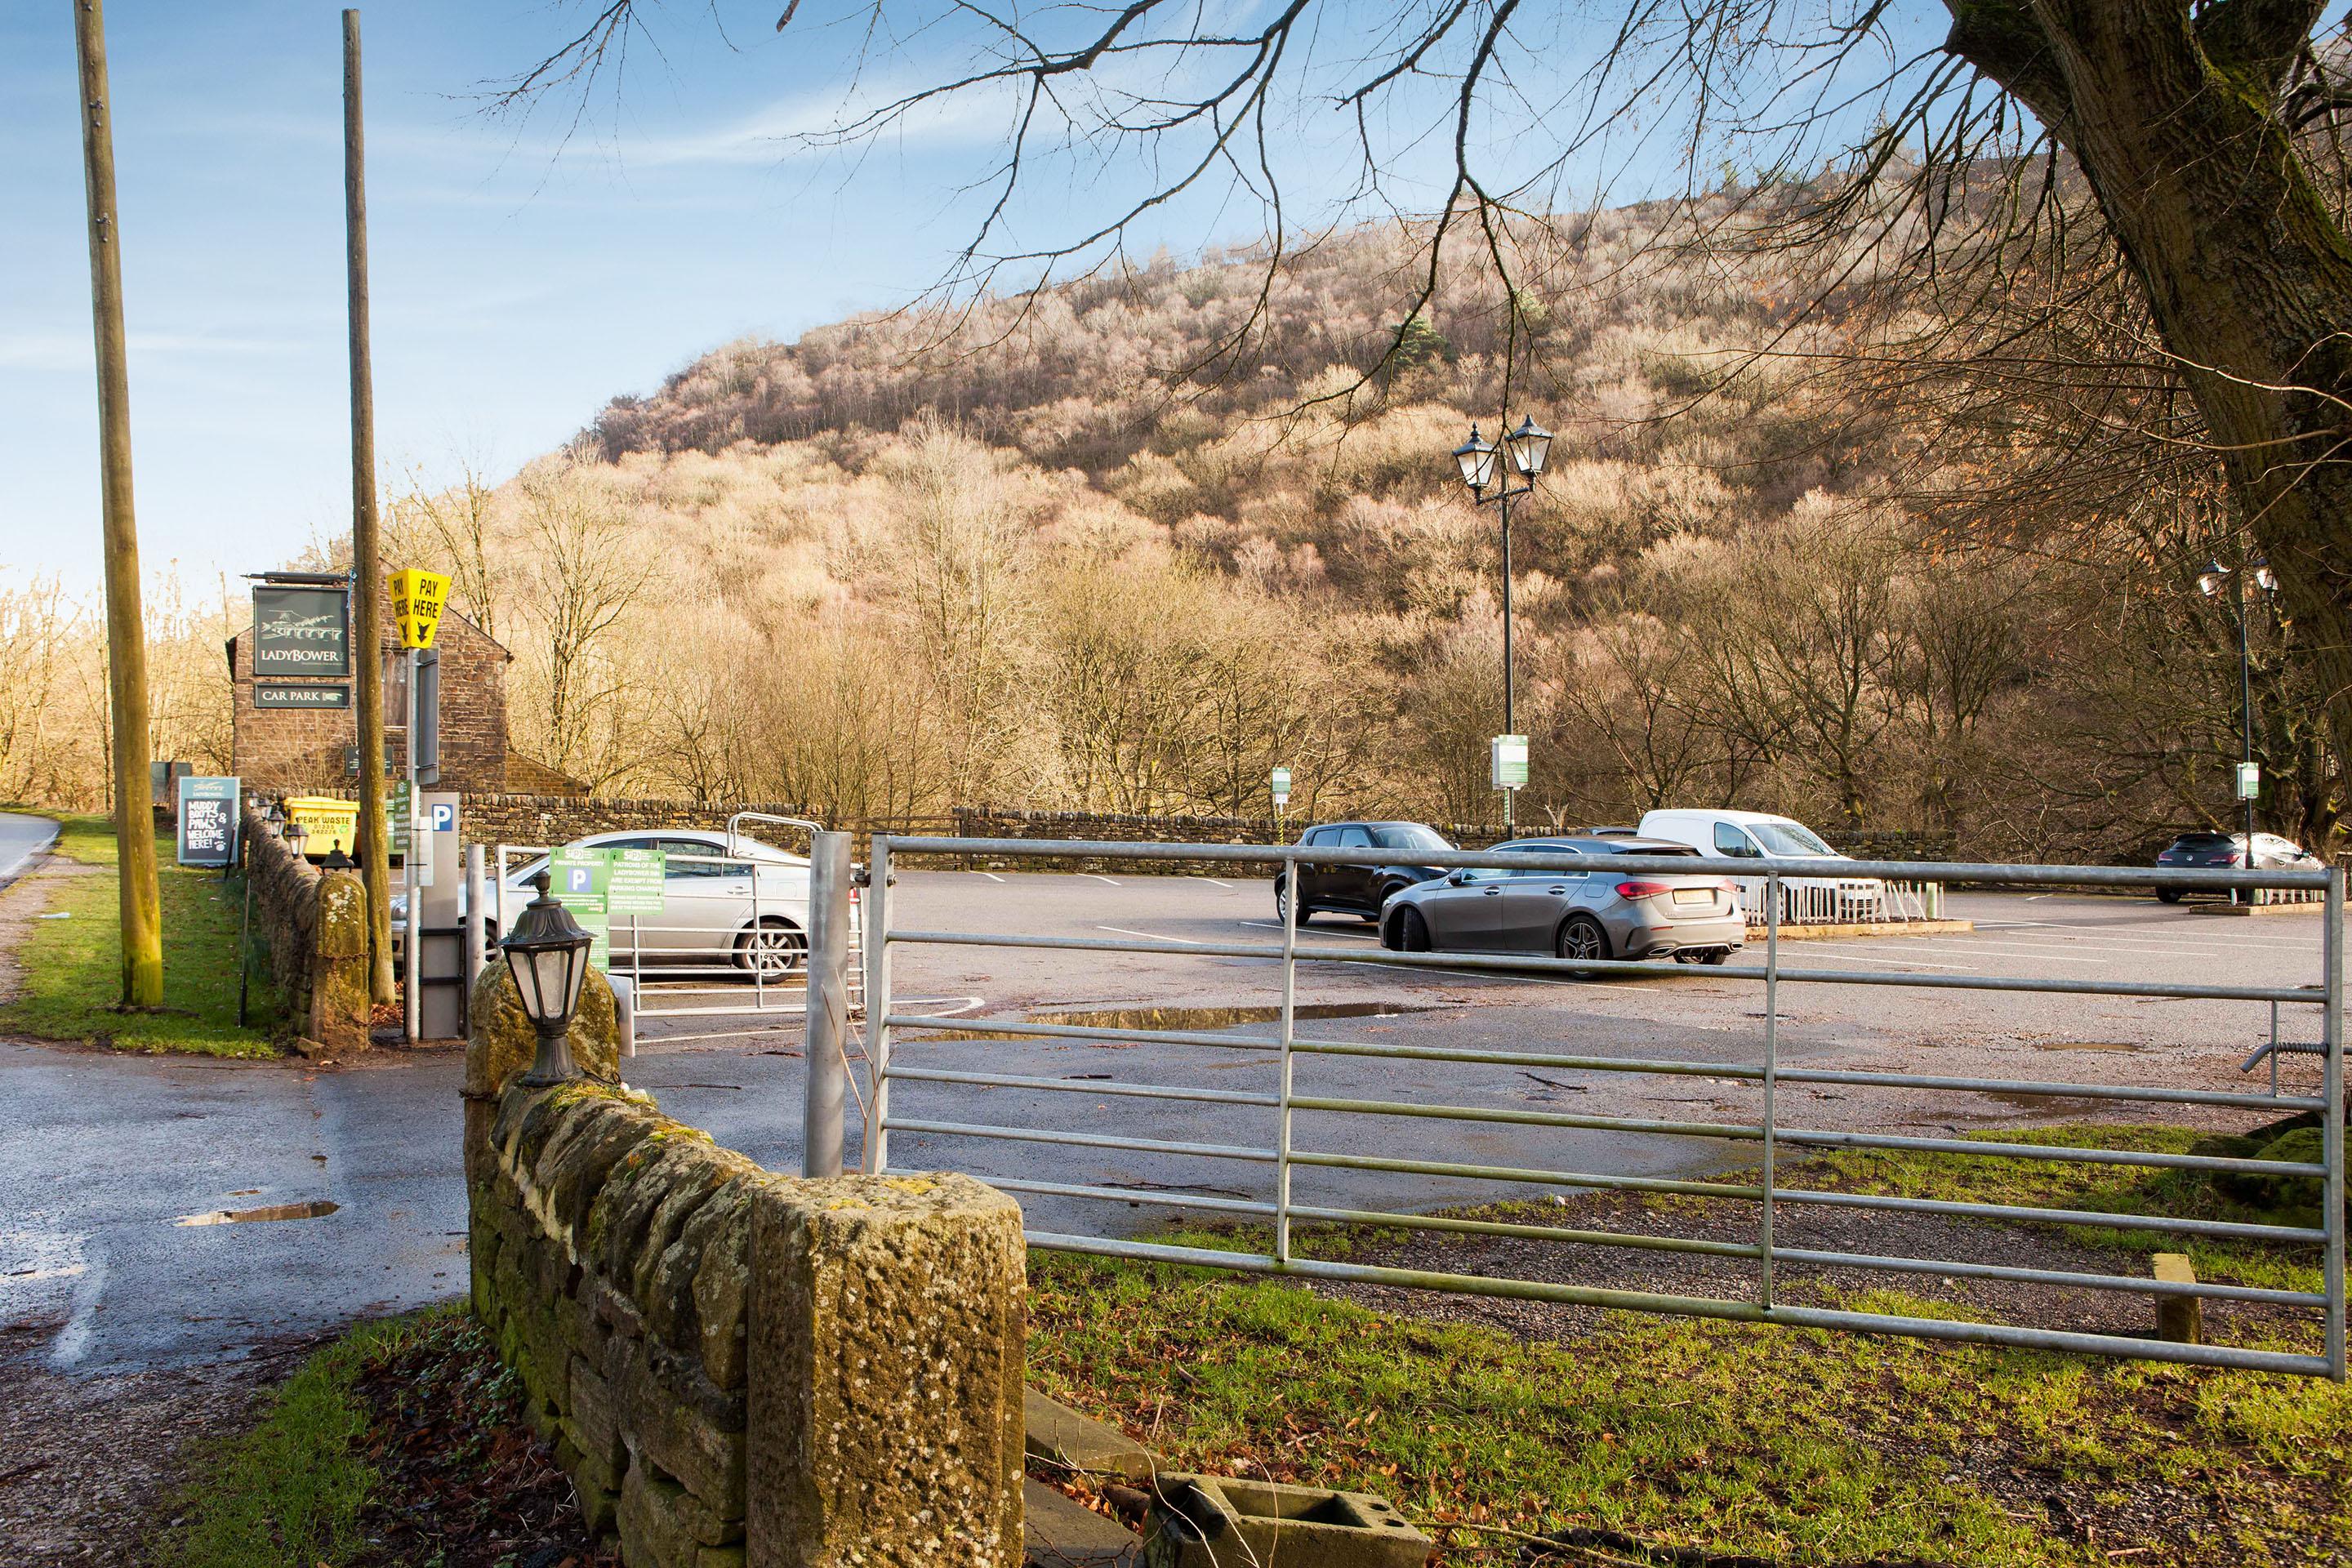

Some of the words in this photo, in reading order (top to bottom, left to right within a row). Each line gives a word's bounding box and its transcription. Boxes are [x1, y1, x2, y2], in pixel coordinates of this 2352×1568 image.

[393, 577, 404, 597] PAY
[419, 578, 439, 597] PAY
[394, 598, 408, 618] HERE
[412, 598, 439, 618] HERE
[261, 649, 339, 662] LADYBOWER
[262, 692, 287, 700] CAR
[290, 692, 319, 701] PARK
[188, 801, 220, 811] MUDDY
[189, 810, 219, 819] BOOTS
[218, 813, 227, 824] &
[297, 816, 319, 824] PEAK
[322, 817, 350, 825] WASTE
[433, 805, 451, 830] P
[189, 818, 217, 830] PAWS
[187, 829, 225, 840] WELCOME
[189, 839, 212, 849] HERE!
[572, 869, 586, 890] P
